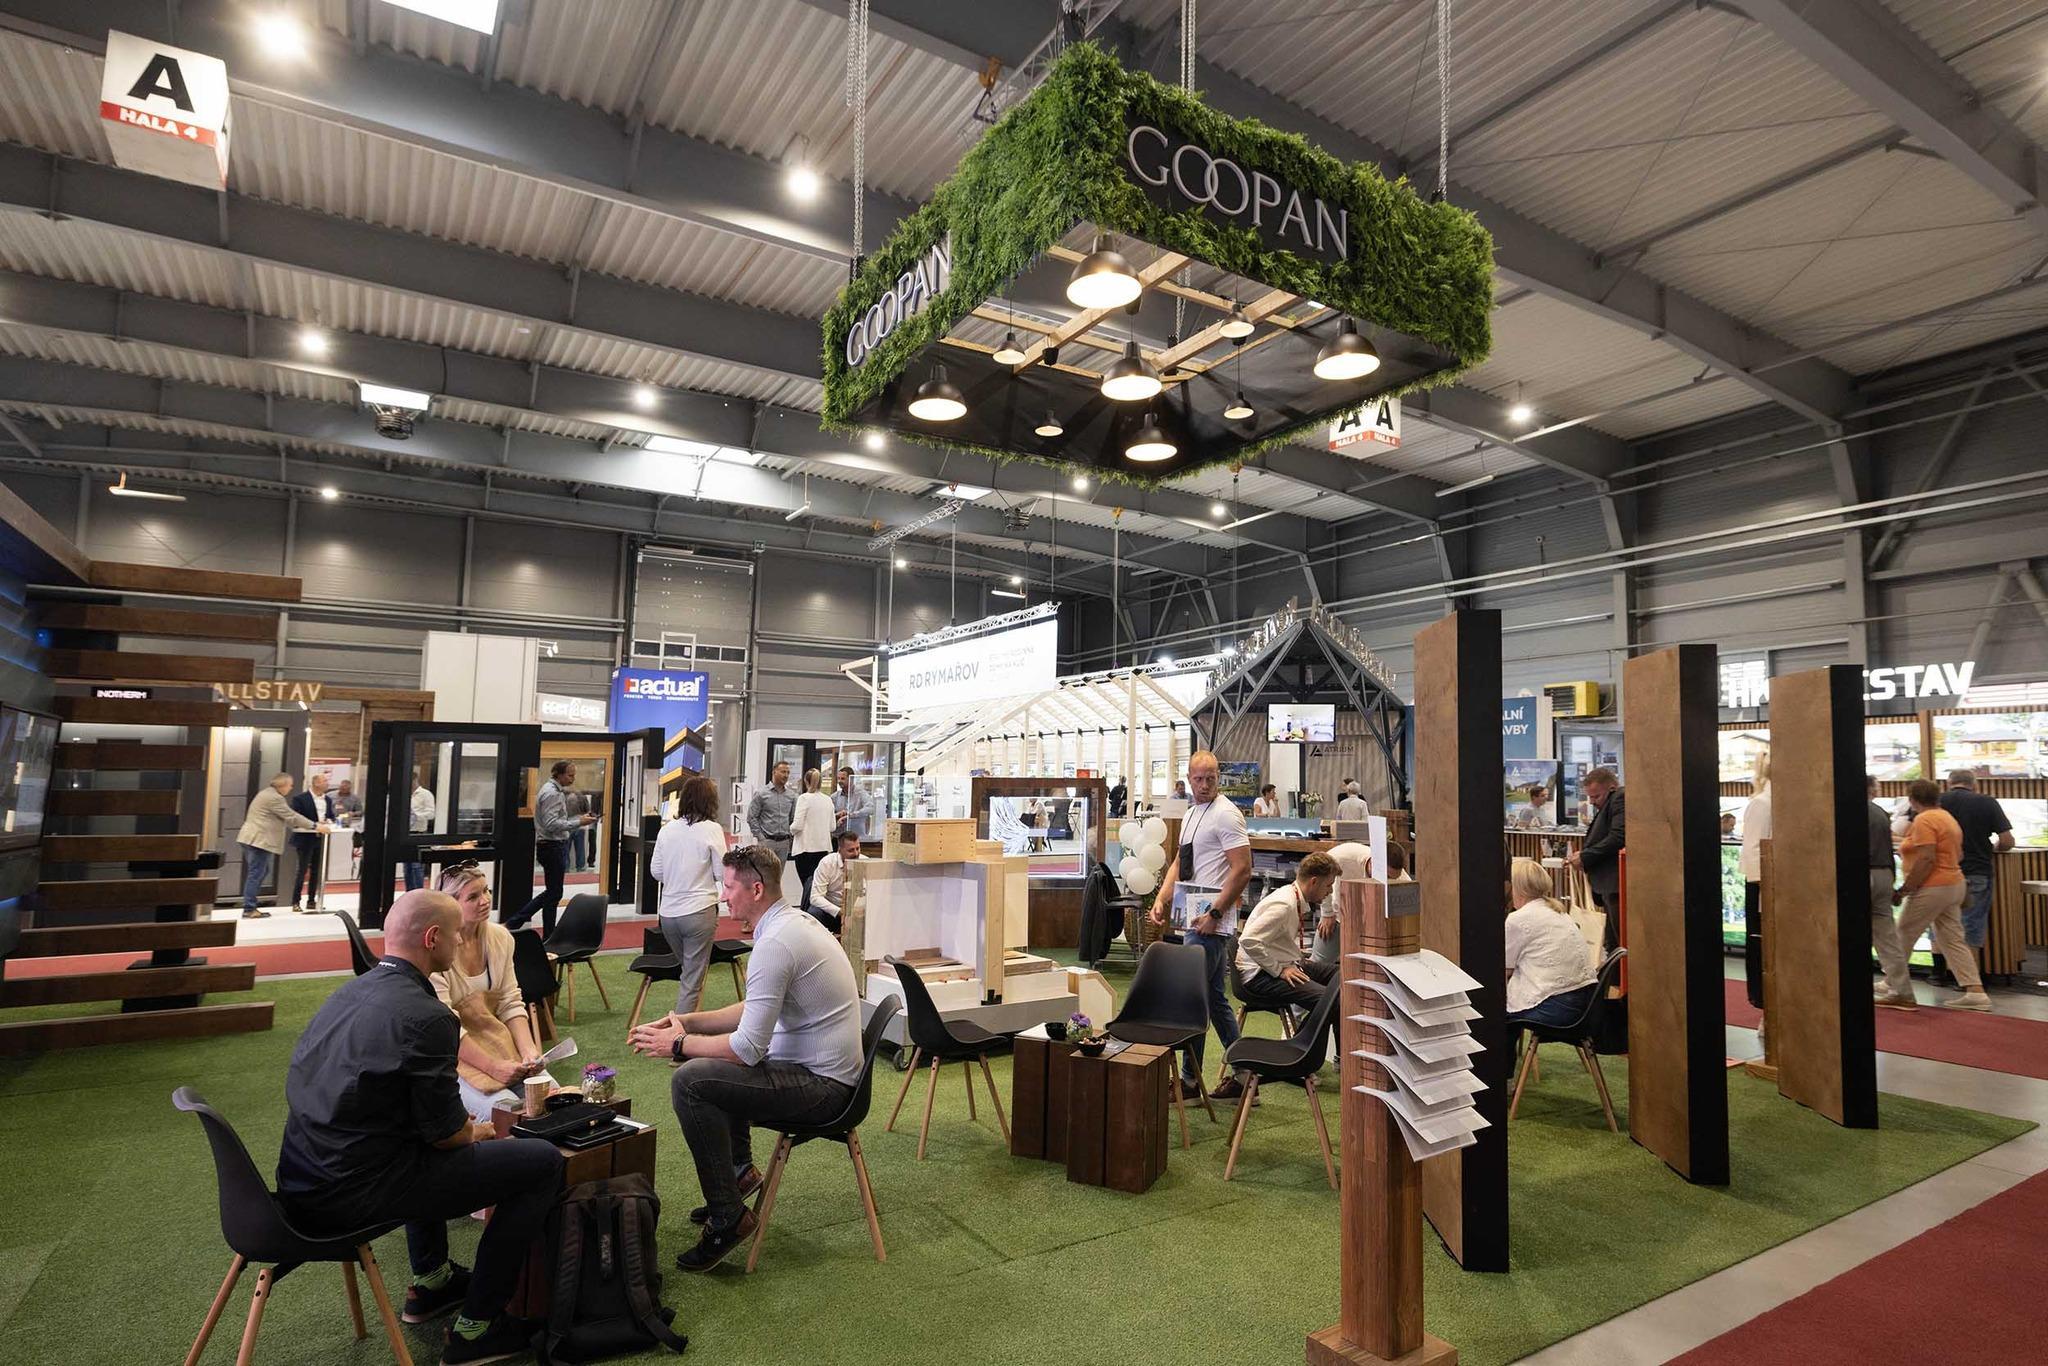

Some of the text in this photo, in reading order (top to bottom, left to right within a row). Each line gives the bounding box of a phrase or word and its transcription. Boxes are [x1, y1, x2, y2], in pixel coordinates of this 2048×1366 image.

[127, 53, 195, 113] A
[119, 107, 199, 140] HALA 4
[1128, 125, 1348, 261] GOOPAN
[846, 229, 953, 367] GOOPAN
[1376, 400, 1394, 431] A
[213, 681, 322, 701] ALLSTAV
[639, 677, 700, 696] actual
[909, 673, 923, 689] RD
